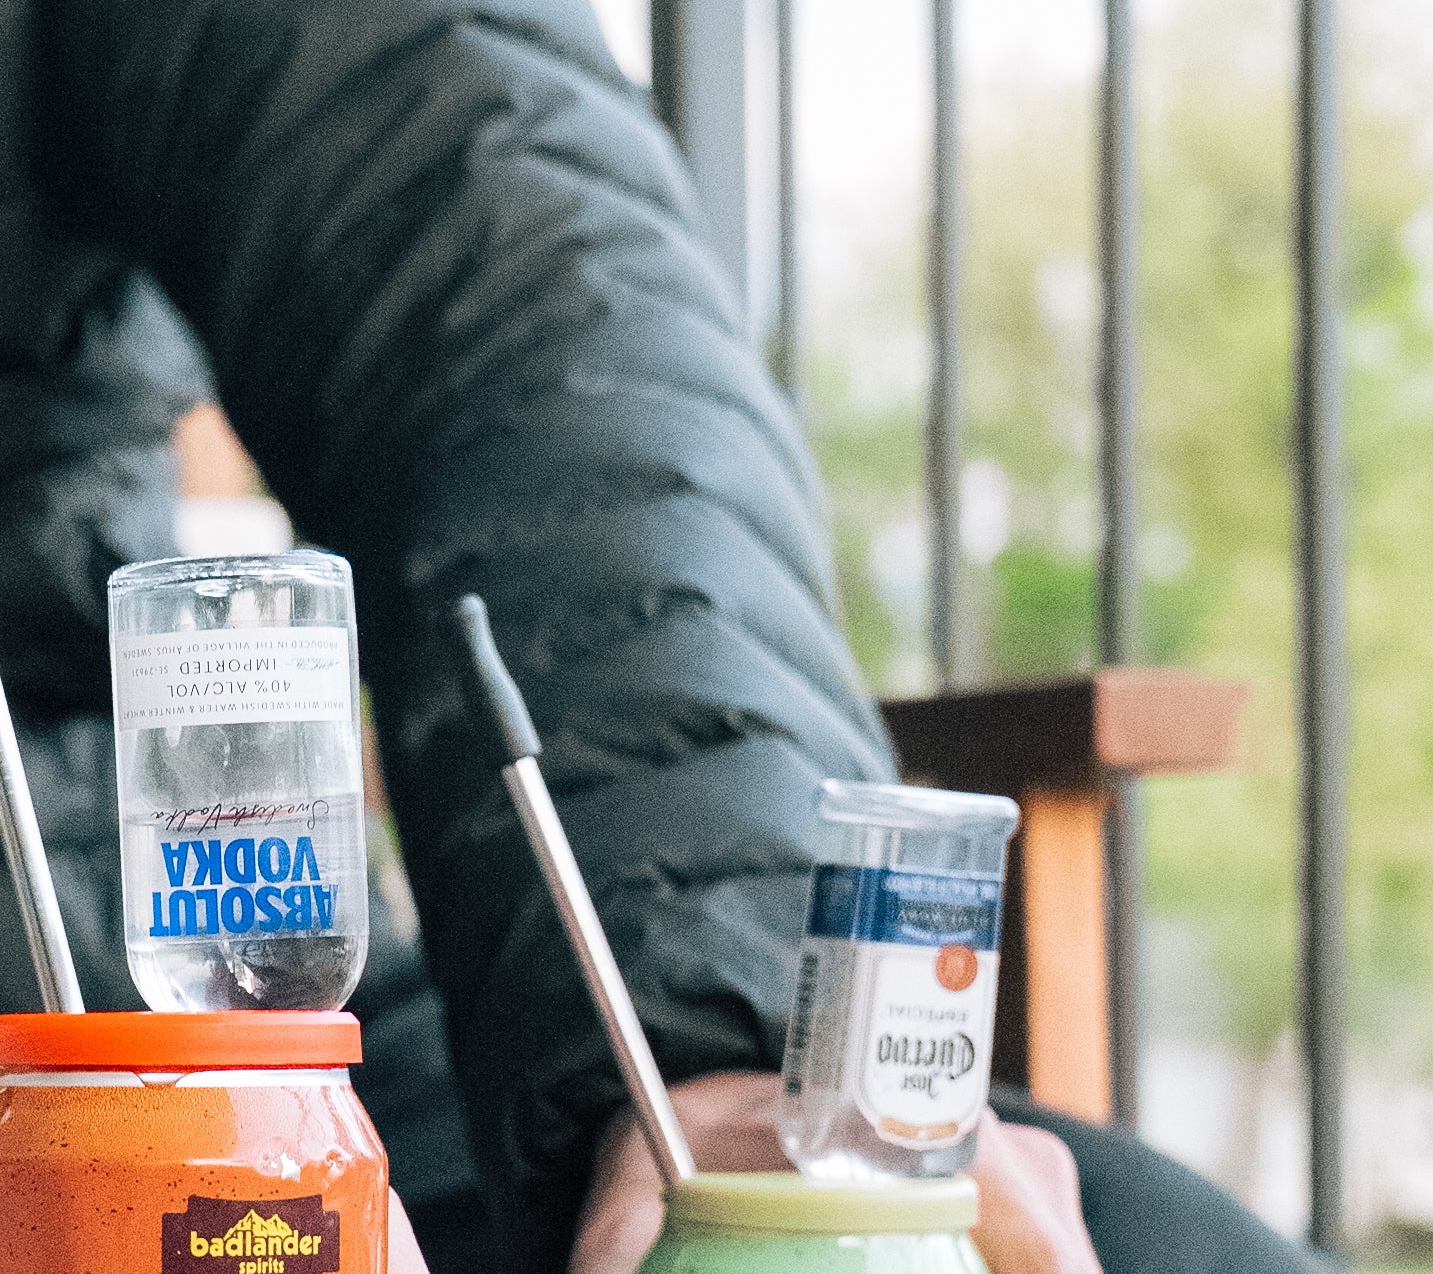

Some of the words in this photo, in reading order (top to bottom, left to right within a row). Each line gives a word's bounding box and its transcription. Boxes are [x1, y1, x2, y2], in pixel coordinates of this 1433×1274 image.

[186, 644, 199, 653] OF
[203, 642, 250, 652] VILLAGE
[256, 641, 274, 649] THE
[277, 641, 287, 650] IN
[291, 640, 338, 649] PRODUCED
[123, 648, 151, 659] SWEDEN
[179, 658, 276, 674] IMPORTED
[167, 682, 246, 698] ALC/VOL
[254, 679, 291, 694] 40%
[189, 705, 195, 714] &
[199, 703, 236, 712] WATER
[241, 701, 291, 711] SWEDISH
[294, 701, 320, 710] WITH
[323, 701, 344, 709] MADE
[148, 706, 184, 717] WINTER
[149, 803, 222, 834] Vodka
[228, 799, 330, 830] Swedish
[161, 837, 321, 887] VODKA
[149, 884, 338, 937] ABSOLUT
[189, 1230, 322, 1258] badlander
